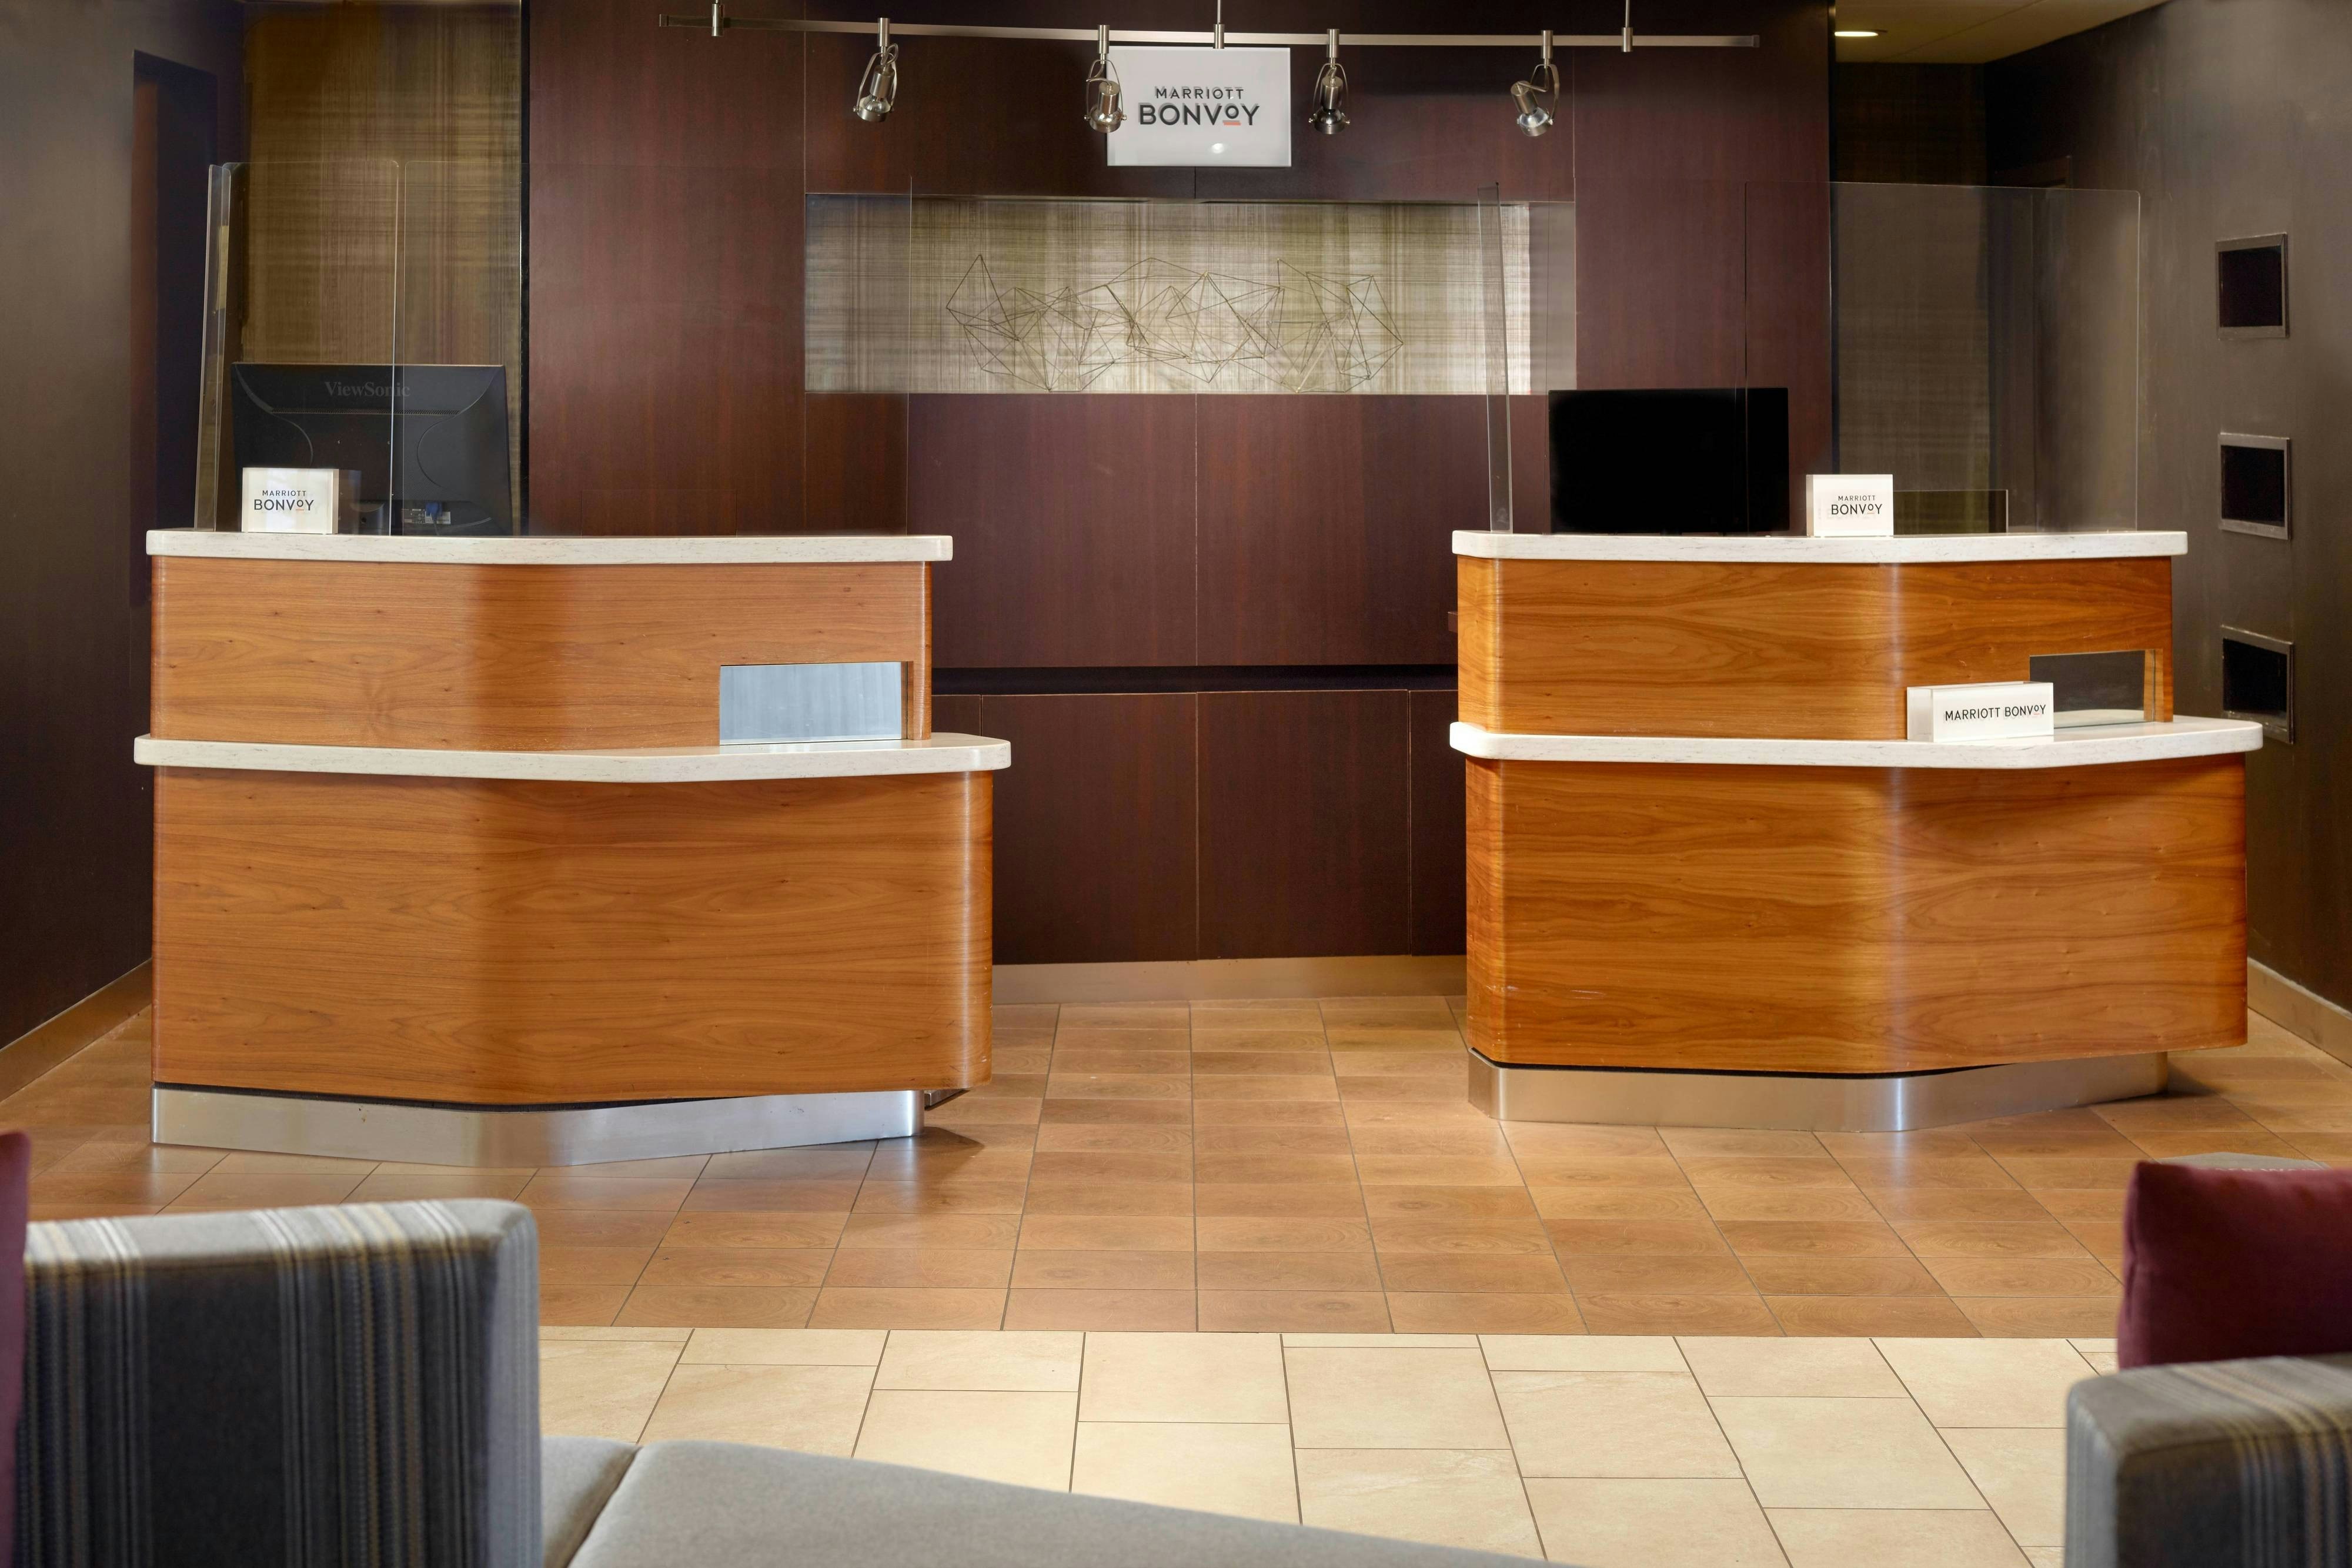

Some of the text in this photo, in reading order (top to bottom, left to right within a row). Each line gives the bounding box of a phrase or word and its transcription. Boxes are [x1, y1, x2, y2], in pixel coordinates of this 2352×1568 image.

[1155, 88, 1245, 99] MARRIOTT
[1140, 104, 1260, 126] BONVOY
[325, 381, 411, 397] ViewSonic
[253, 499, 315, 511] BONVOY
[1831, 503, 1883, 515] BONVOY
[1945, 704, 2047, 721] MARRIOTT BONVOY
